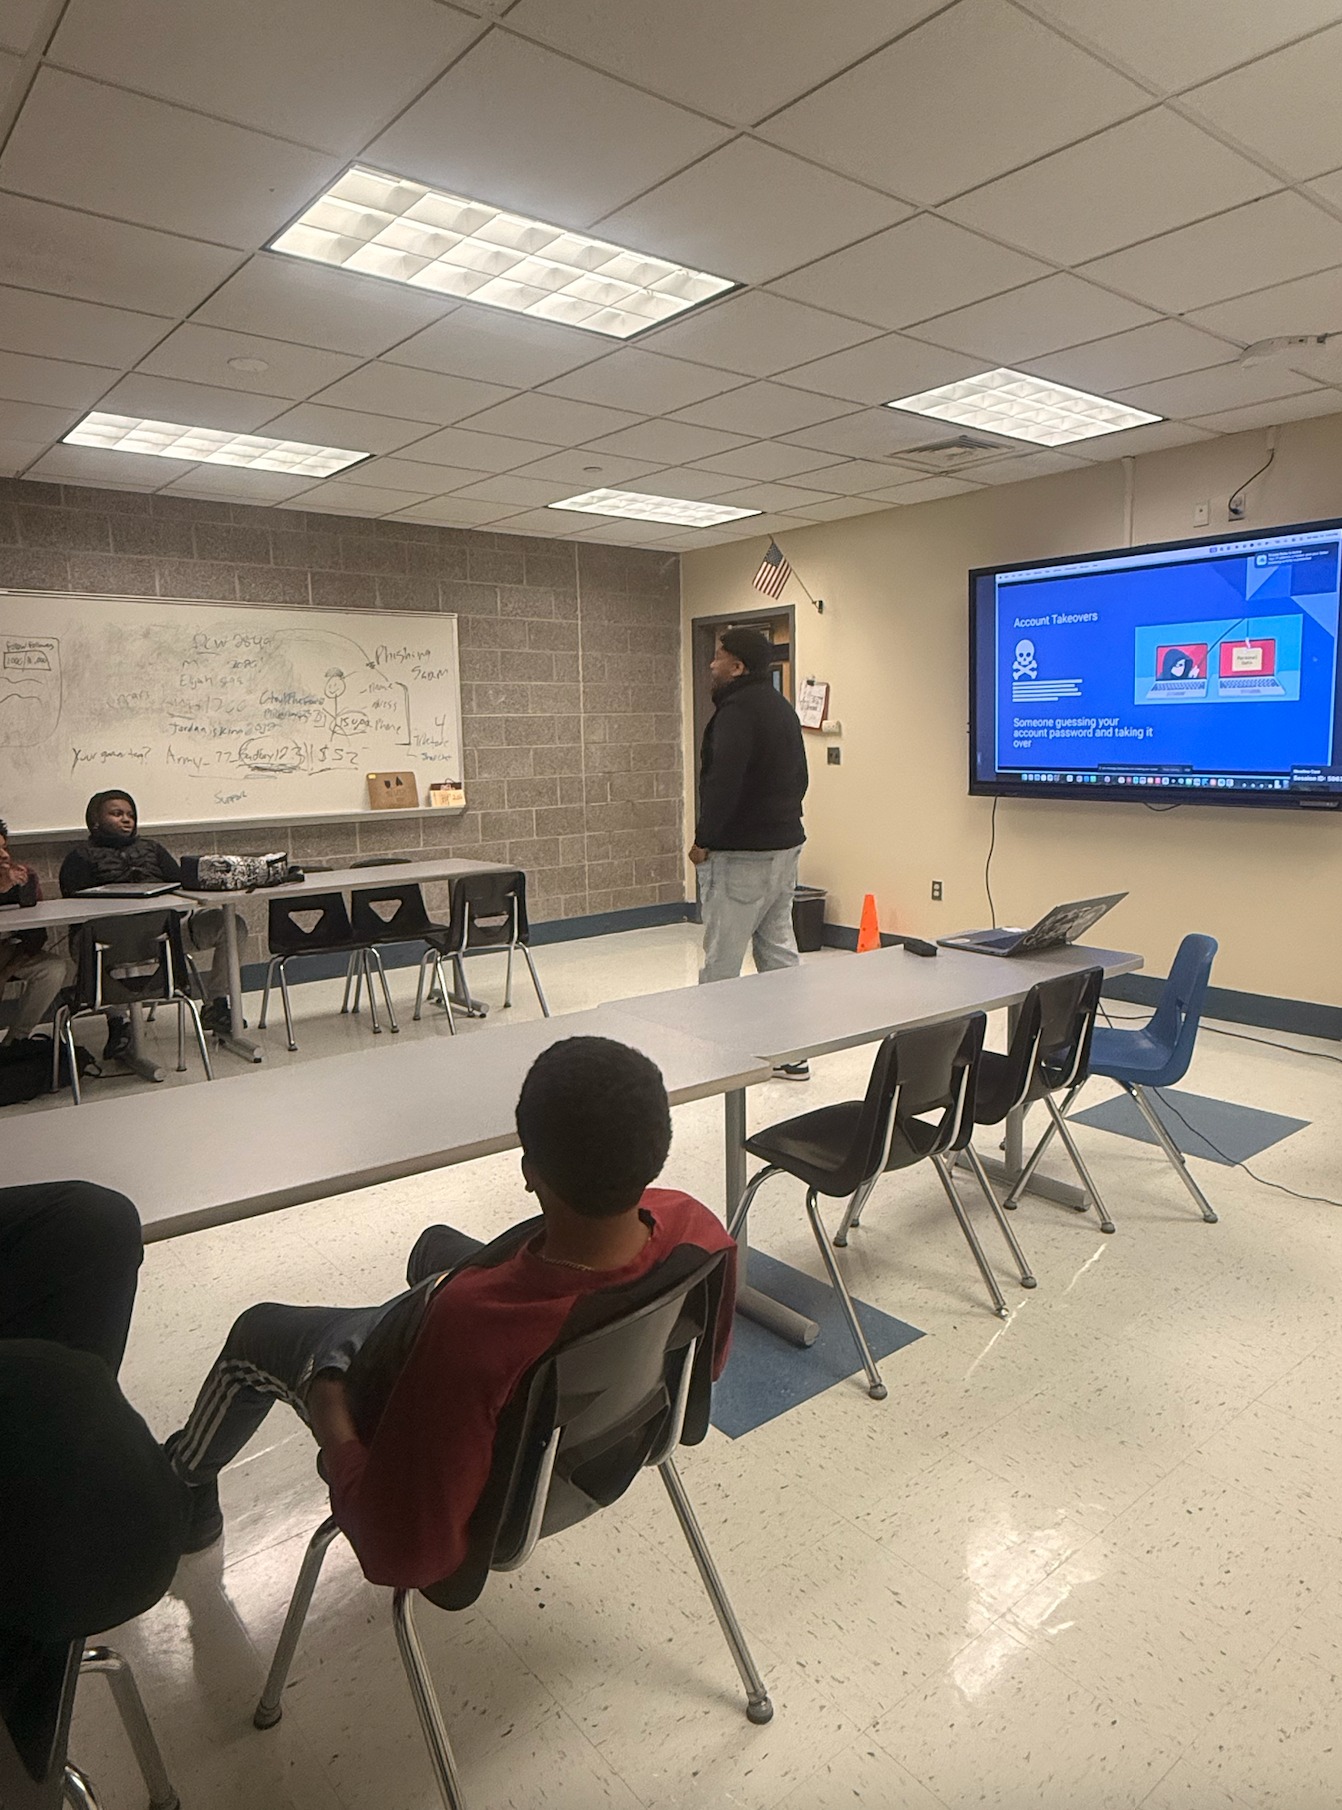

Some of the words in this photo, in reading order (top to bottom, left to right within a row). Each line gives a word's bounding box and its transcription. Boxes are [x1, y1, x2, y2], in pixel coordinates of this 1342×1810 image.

[1013, 615, 1050, 628] Account
[1051, 612, 1098, 625] Takeovers
[375, 645, 431, 665] Phishing
[1013, 717, 1054, 728] Someone
[1055, 717, 1096, 729] guessing
[1098, 717, 1119, 728] your
[1013, 728, 1048, 738] account
[1049, 727, 1094, 739] password
[1095, 727, 1113, 738] and
[1114, 727, 1144, 739] taking
[1145, 727, 1154, 738] it
[1013, 740, 1032, 748] over
